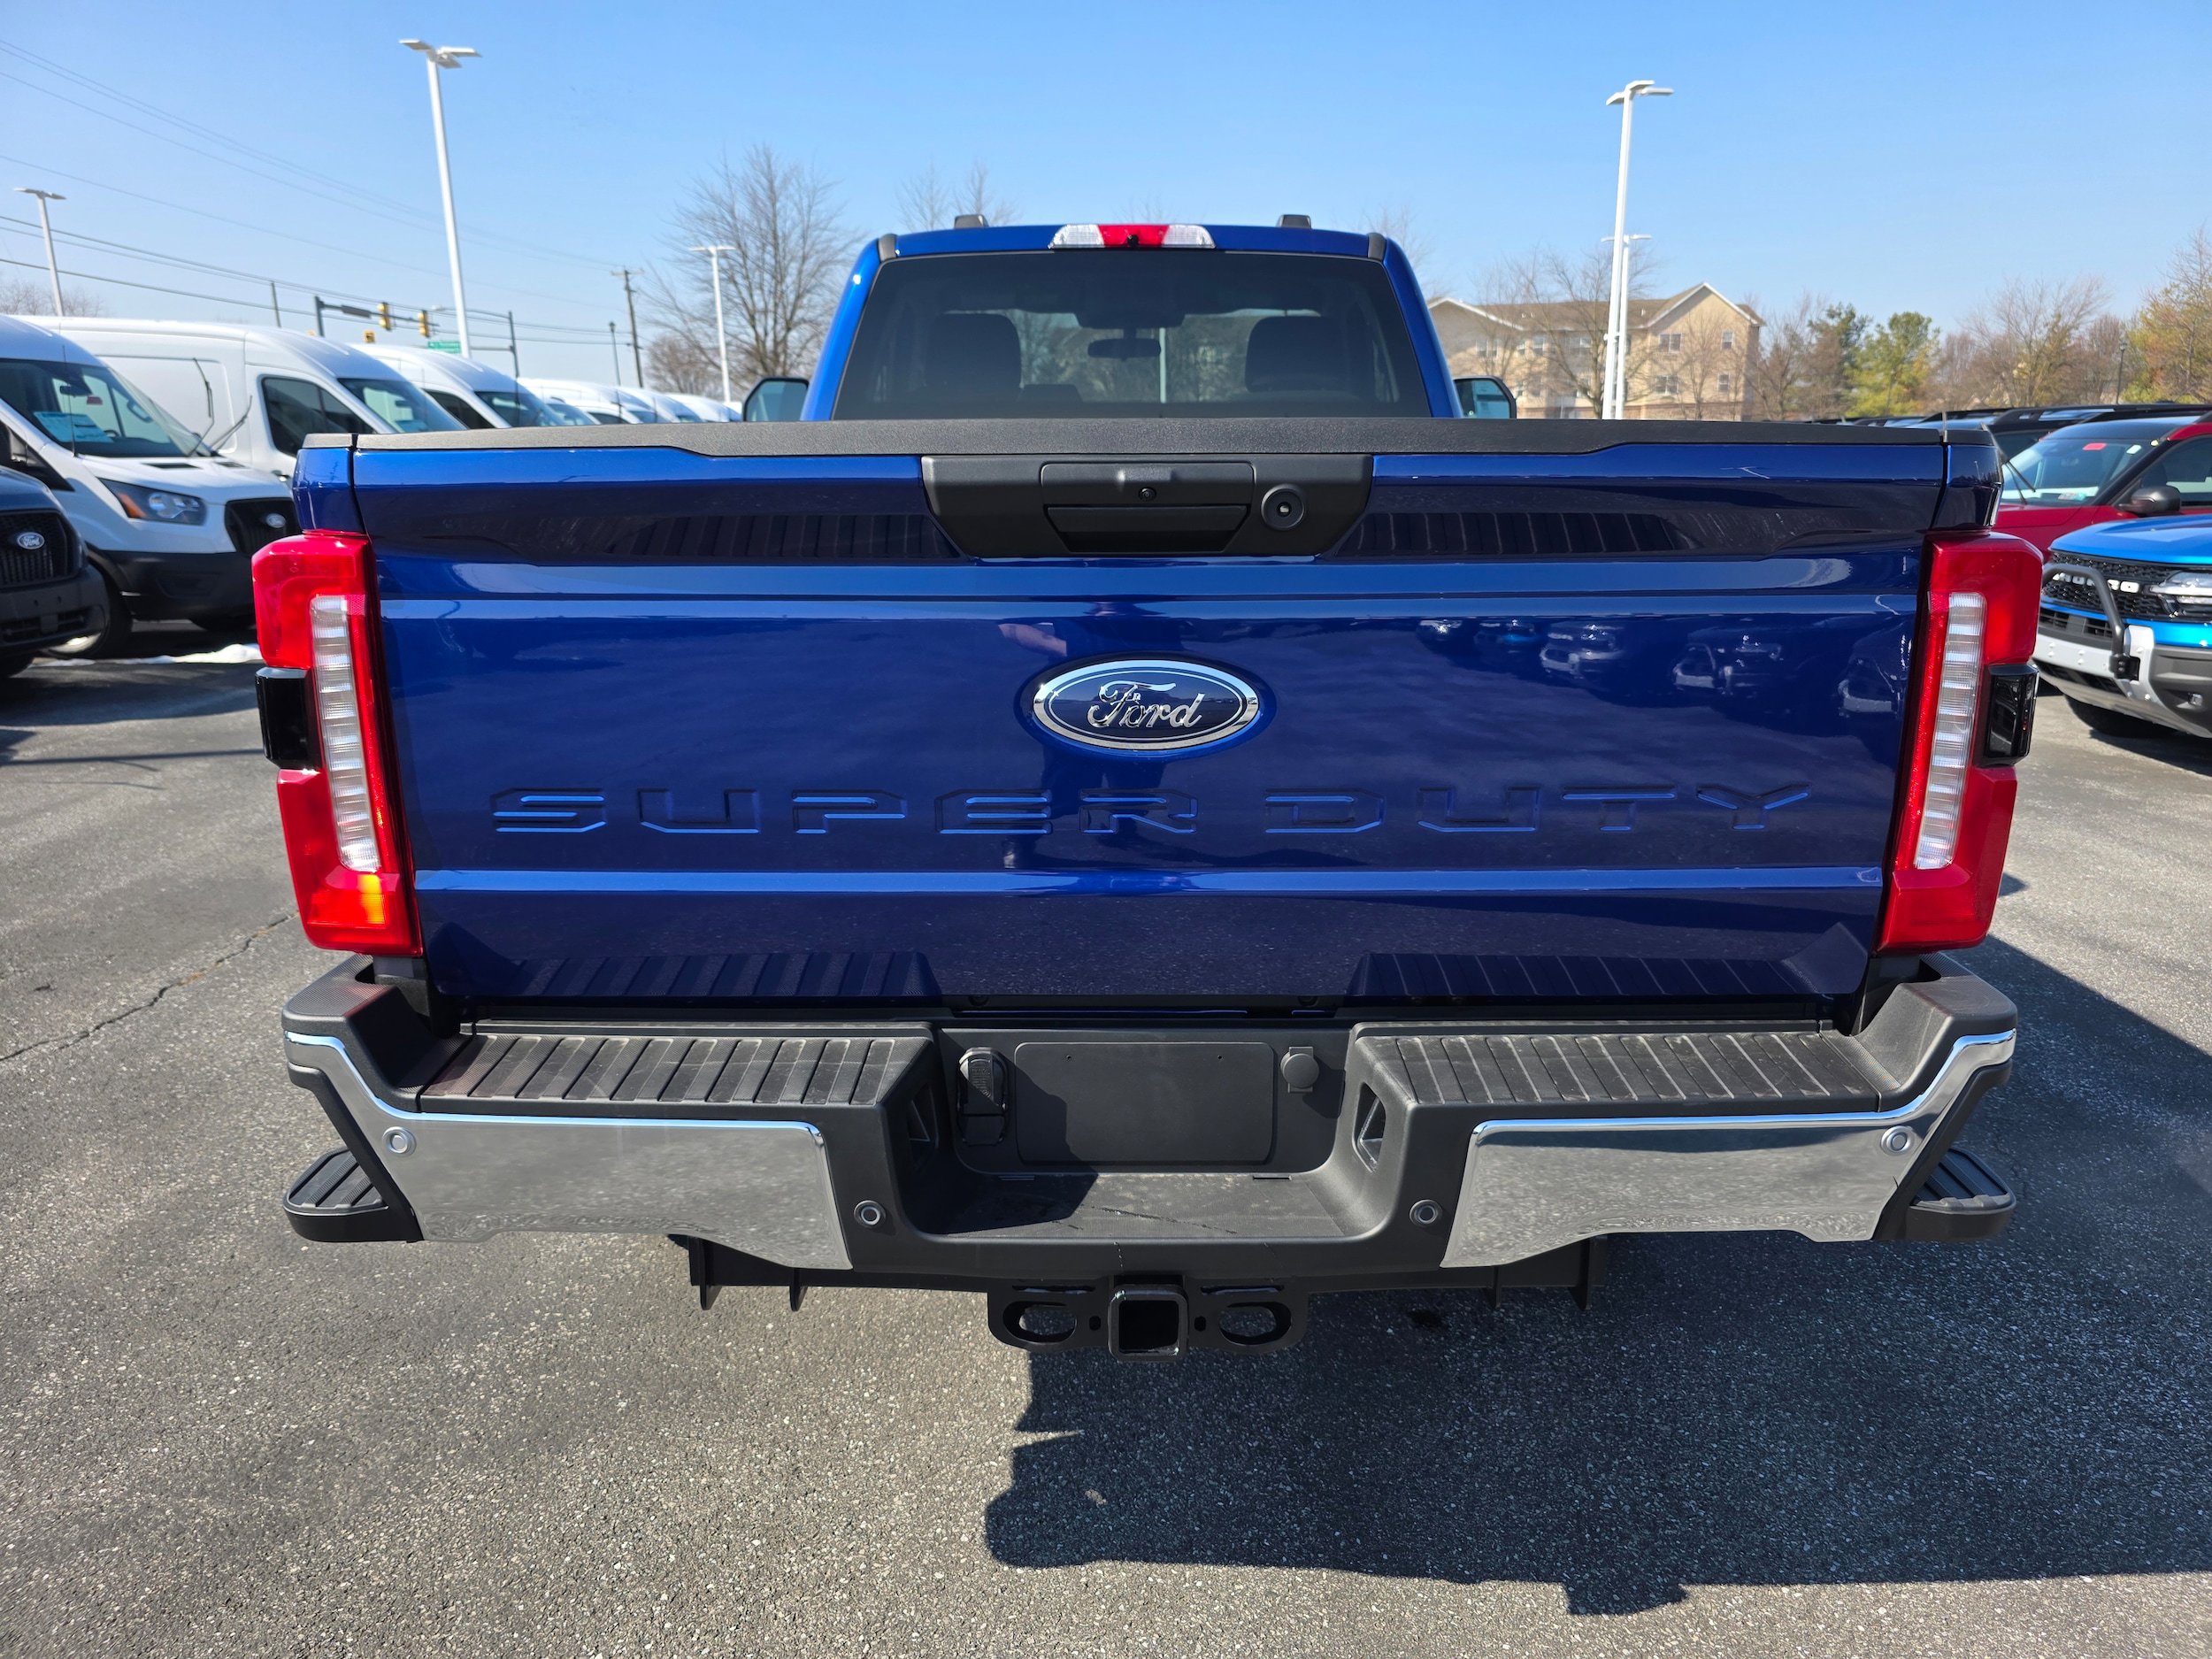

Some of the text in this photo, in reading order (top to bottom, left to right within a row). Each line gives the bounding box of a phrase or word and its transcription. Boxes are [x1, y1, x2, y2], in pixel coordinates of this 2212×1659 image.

[1087, 680, 1206, 728] Ford
[489, 783, 1812, 834] SUPER DUTY
